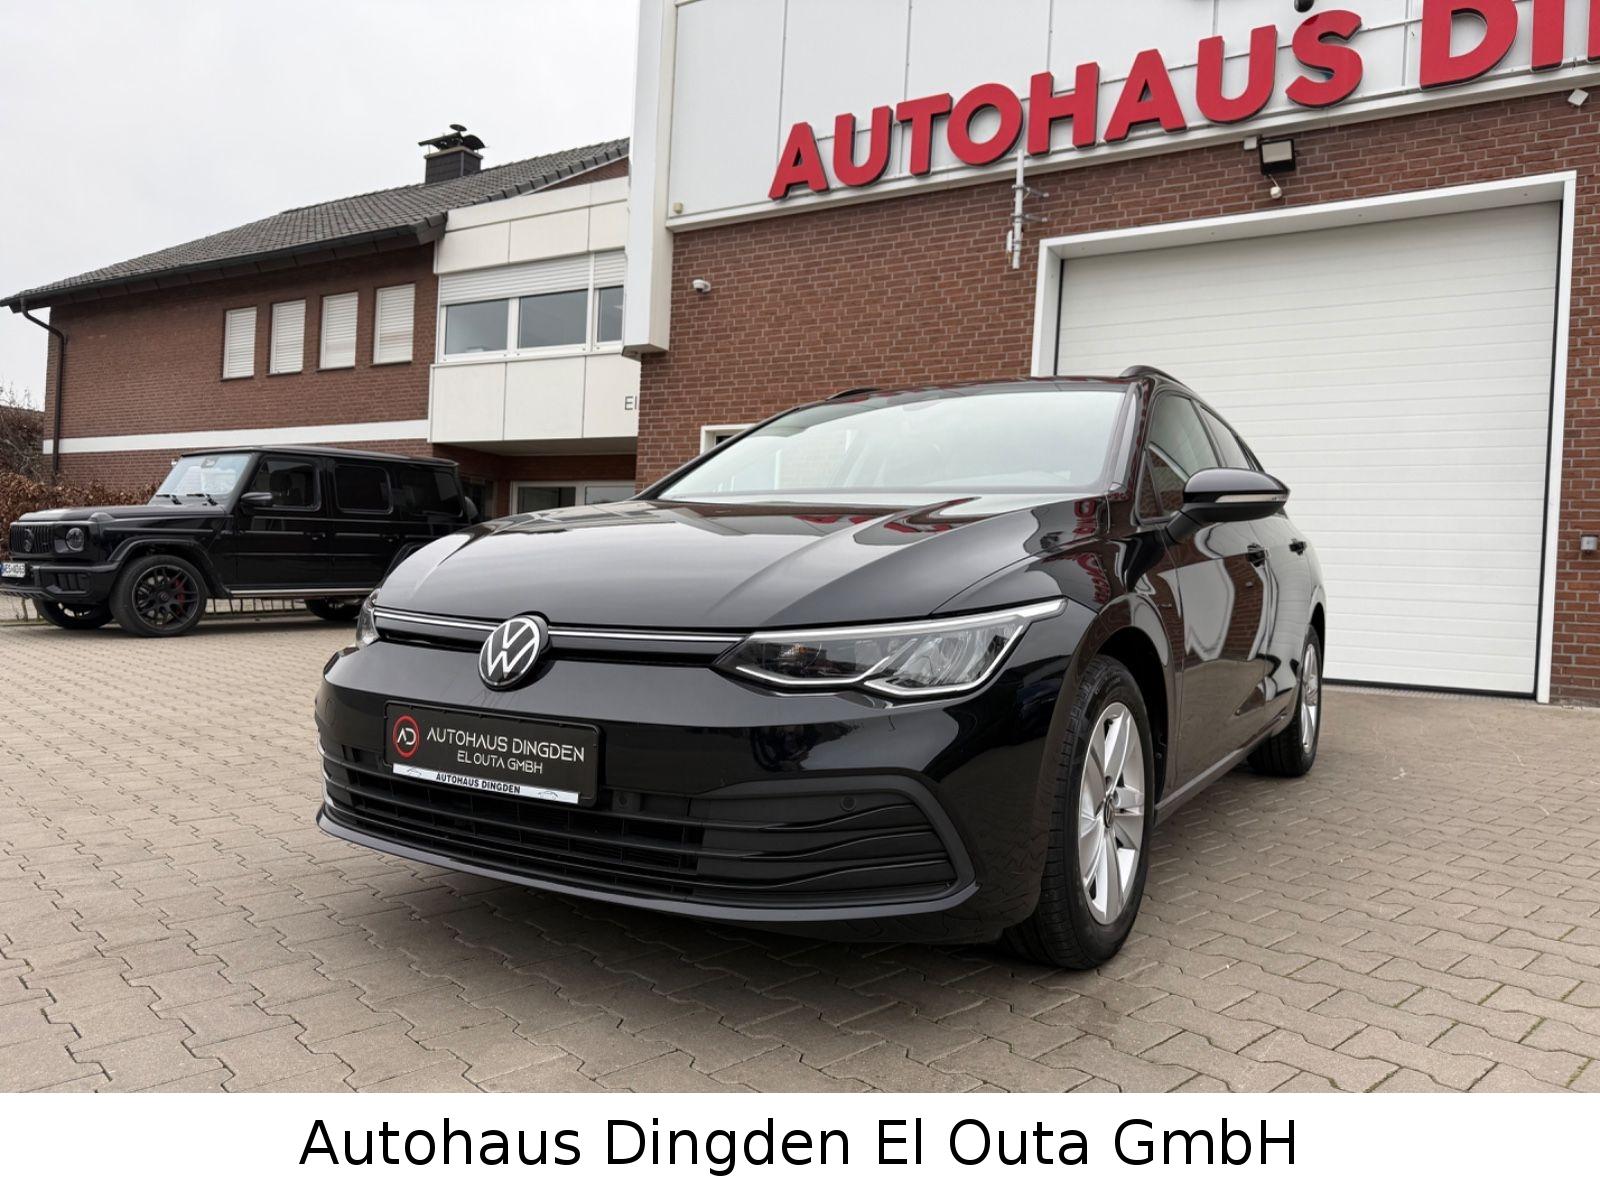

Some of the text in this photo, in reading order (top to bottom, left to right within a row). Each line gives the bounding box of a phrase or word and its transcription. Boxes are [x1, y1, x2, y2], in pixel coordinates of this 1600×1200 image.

[769, 0, 1600, 200] AUTOHAUS DI
[484, 620, 539, 681] VW
[426, 727, 585, 763] AUTOHAUS DINGDEN
[457, 750, 544, 775] EL OUTA GMBH
[435, 773, 521, 794] AUTOHAUS DINGDEN
